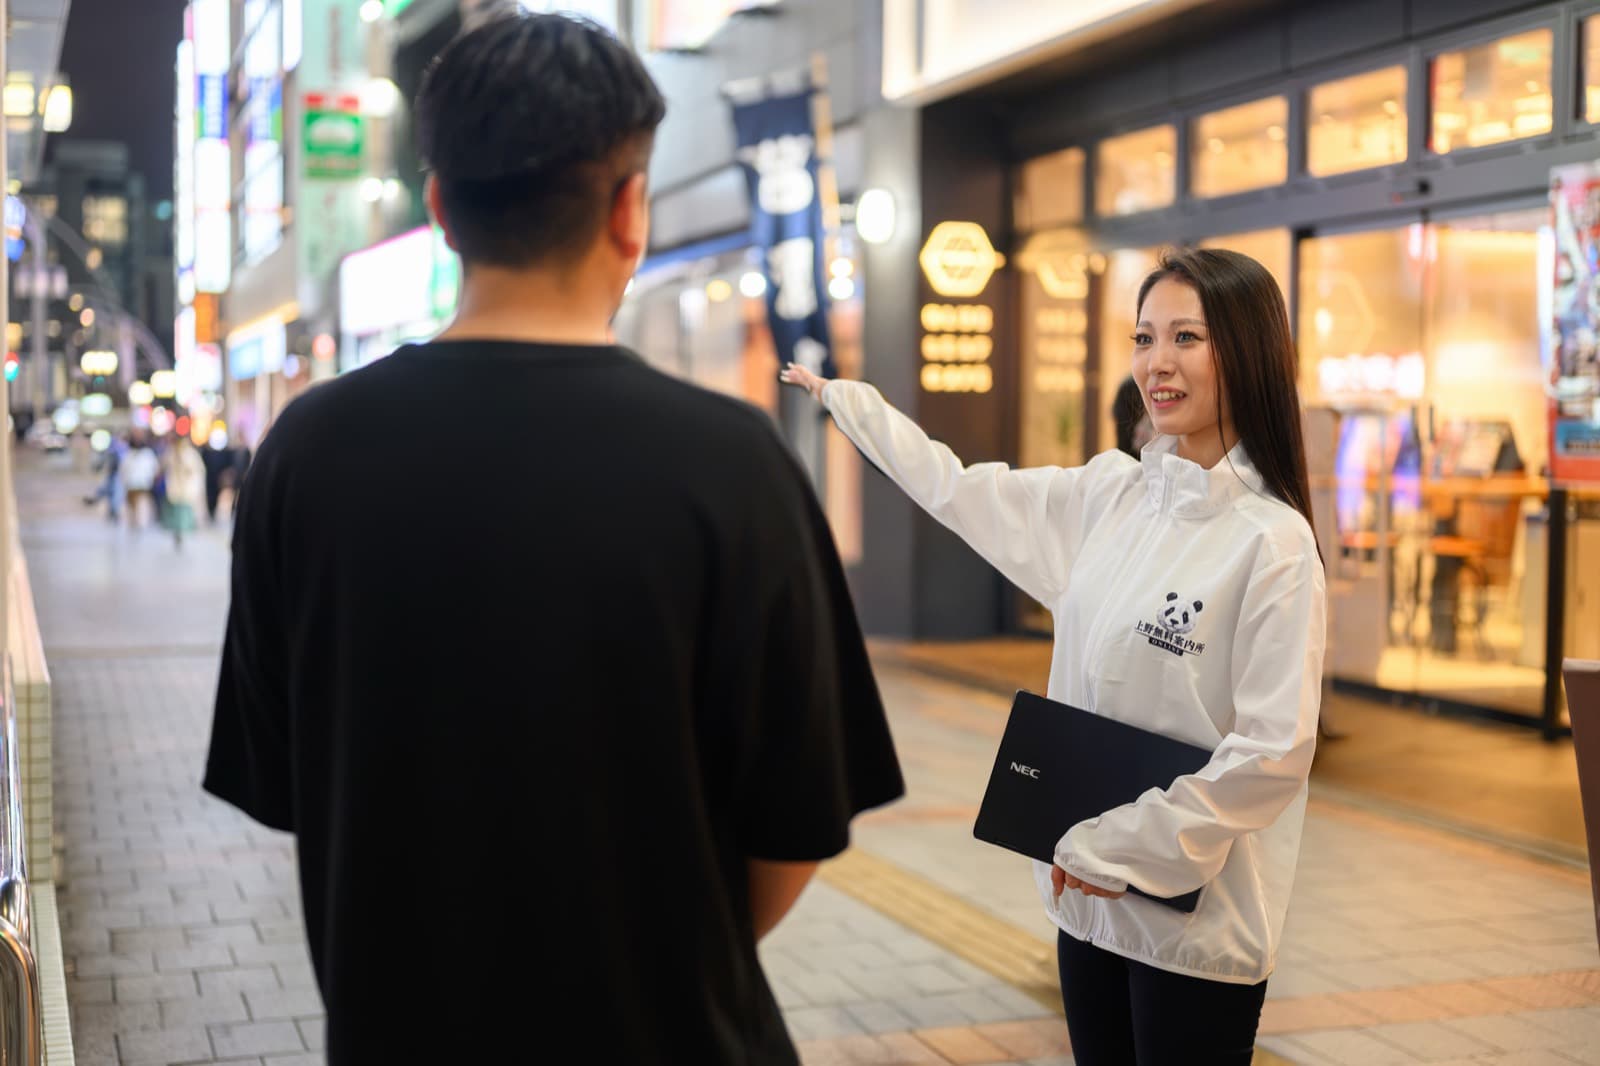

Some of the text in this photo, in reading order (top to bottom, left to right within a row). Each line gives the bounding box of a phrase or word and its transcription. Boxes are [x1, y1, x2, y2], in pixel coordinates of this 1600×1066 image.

[1136, 620, 1205, 654] 上野無料案内所
[1151, 638, 1181, 655] ONLINE
[1010, 761, 1040, 779] NEC
